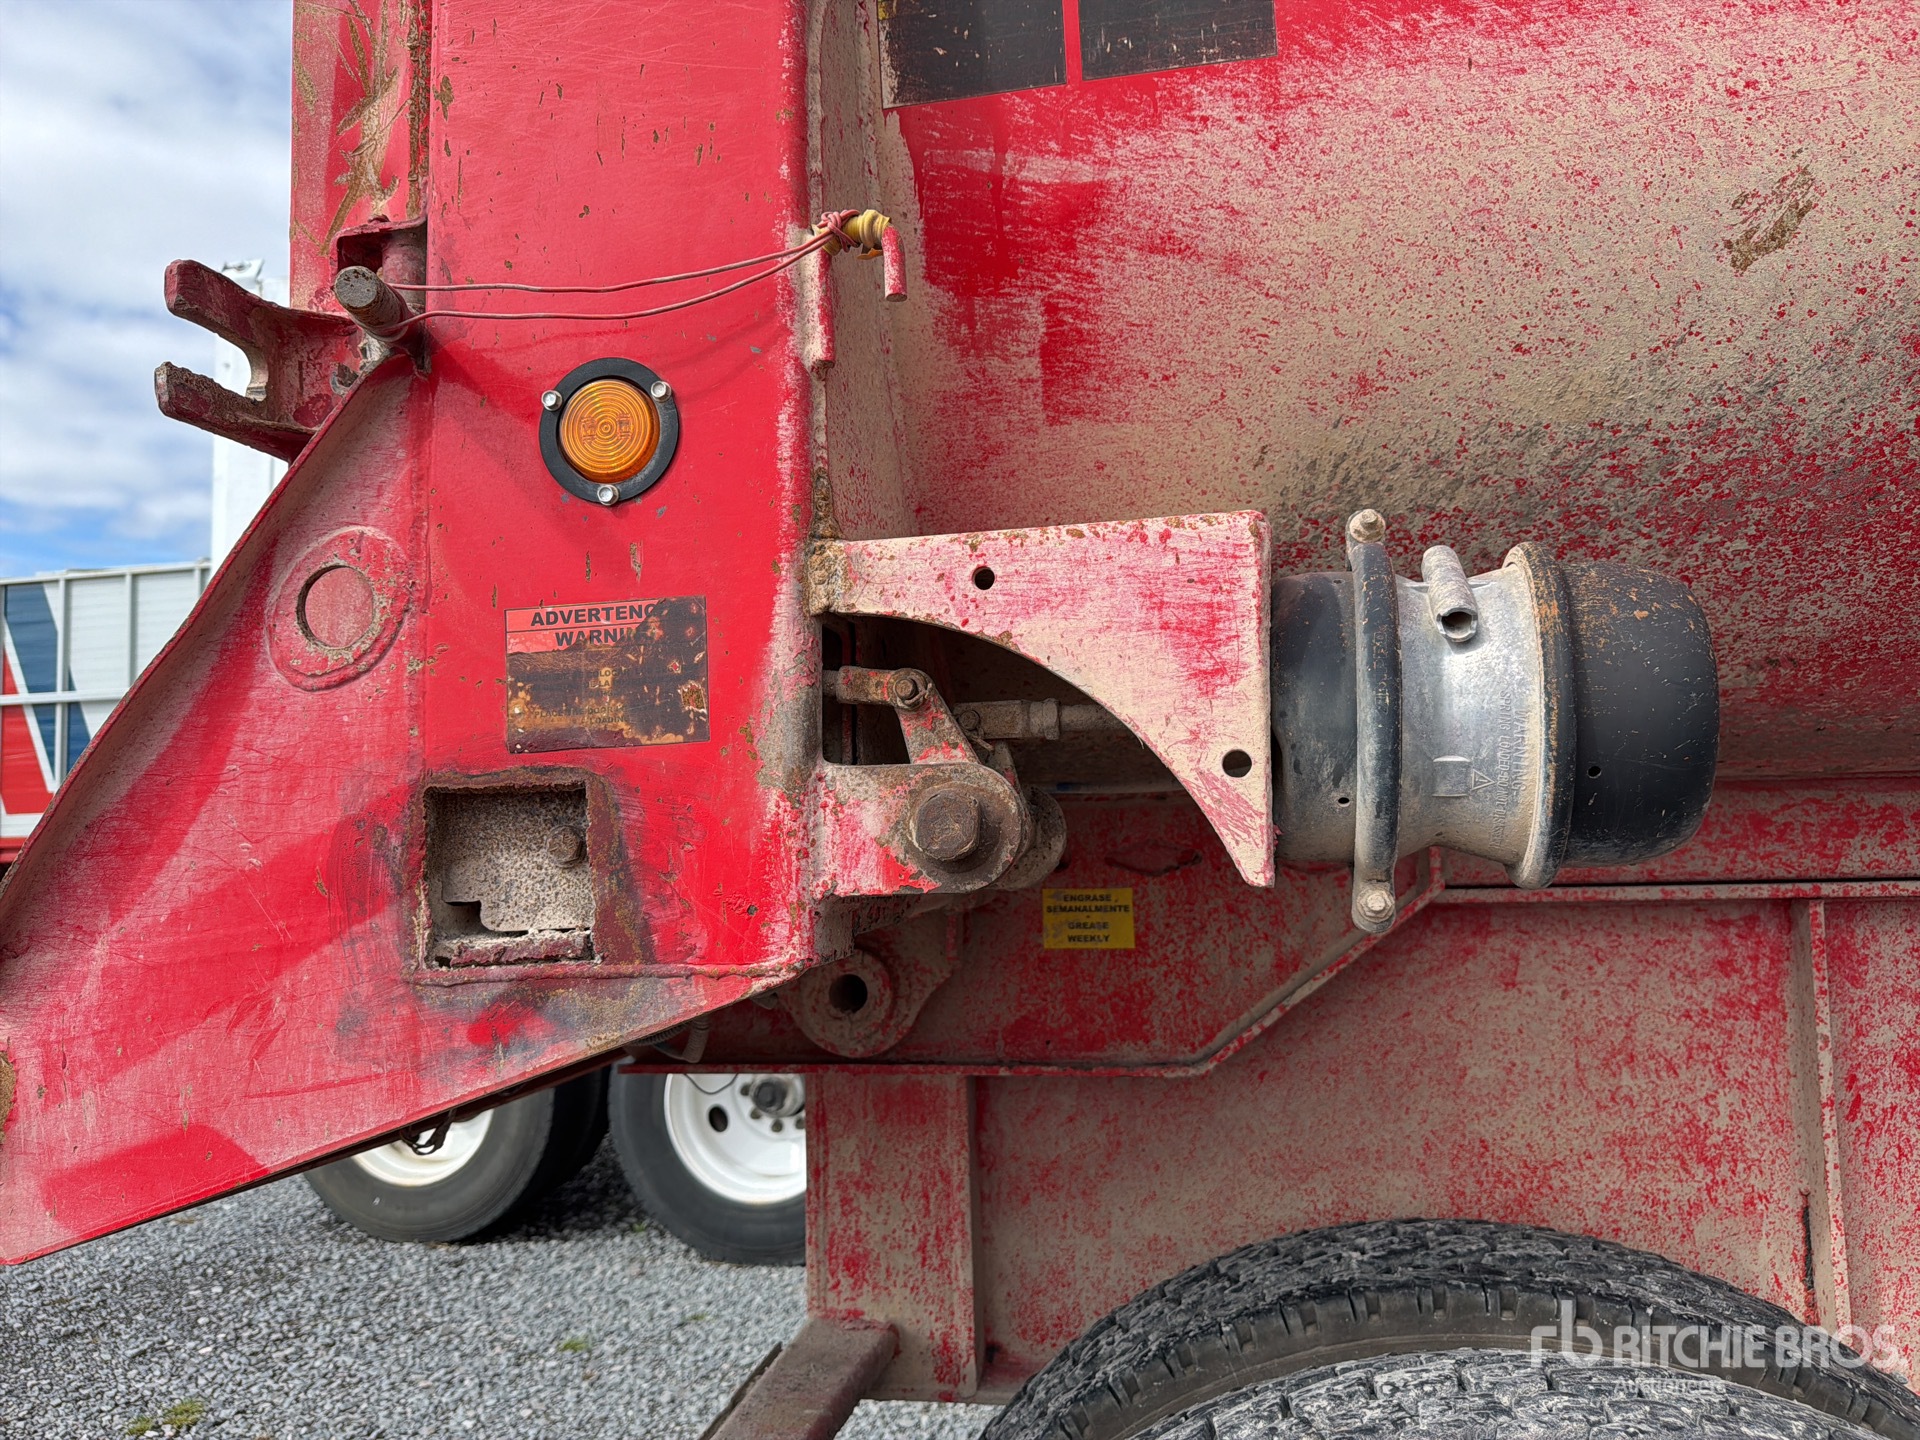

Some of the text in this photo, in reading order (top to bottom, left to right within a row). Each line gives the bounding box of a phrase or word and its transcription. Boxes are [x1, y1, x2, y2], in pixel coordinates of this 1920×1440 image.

[531, 603, 660, 627] ADVERTENC
[1063, 893, 1112, 902] ENGRASE
[1067, 921, 1110, 930] GREASE
[1066, 934, 1111, 943] WEEKLY
